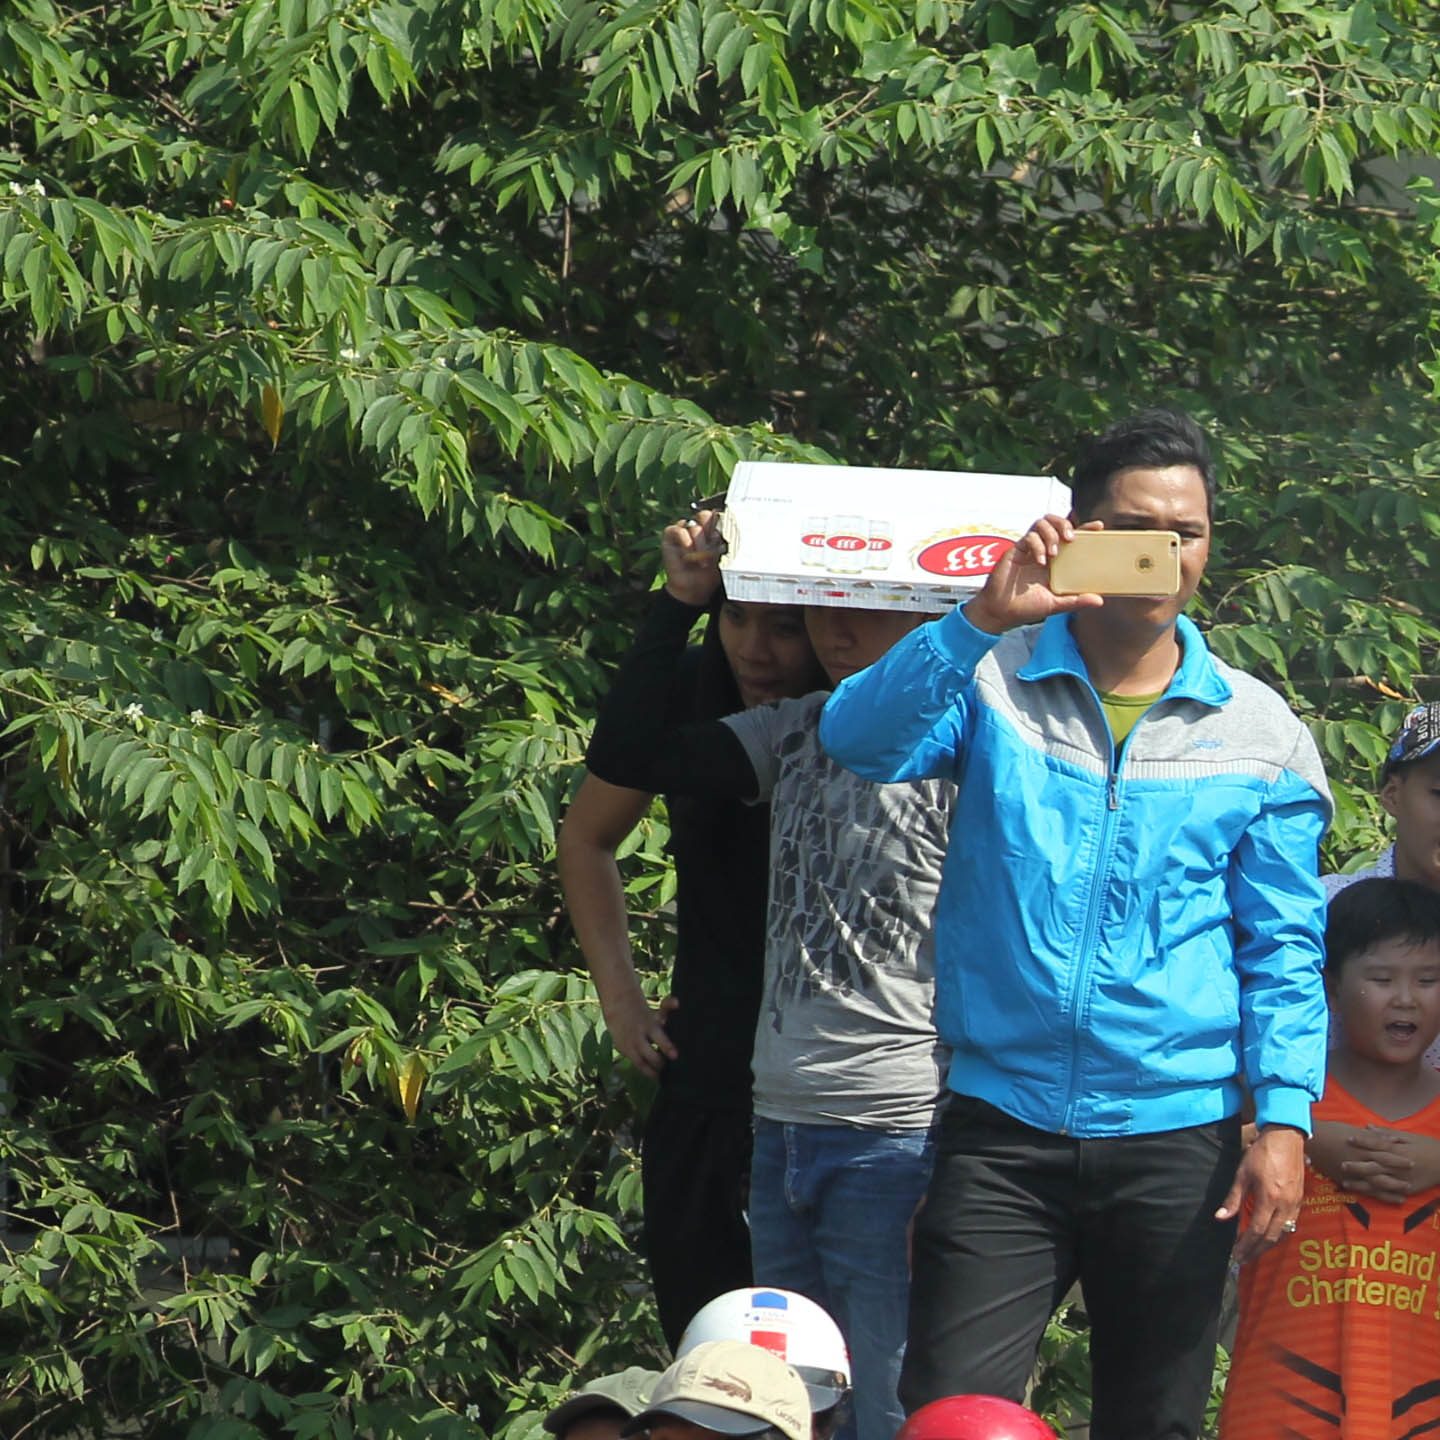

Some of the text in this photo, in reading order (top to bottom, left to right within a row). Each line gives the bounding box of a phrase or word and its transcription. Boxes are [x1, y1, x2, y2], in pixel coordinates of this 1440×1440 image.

[1303, 1194, 1357, 1206] HAMPIONS
[1299, 1240, 1437, 1281] Standard
[1286, 1273, 1428, 1314] Chartered
